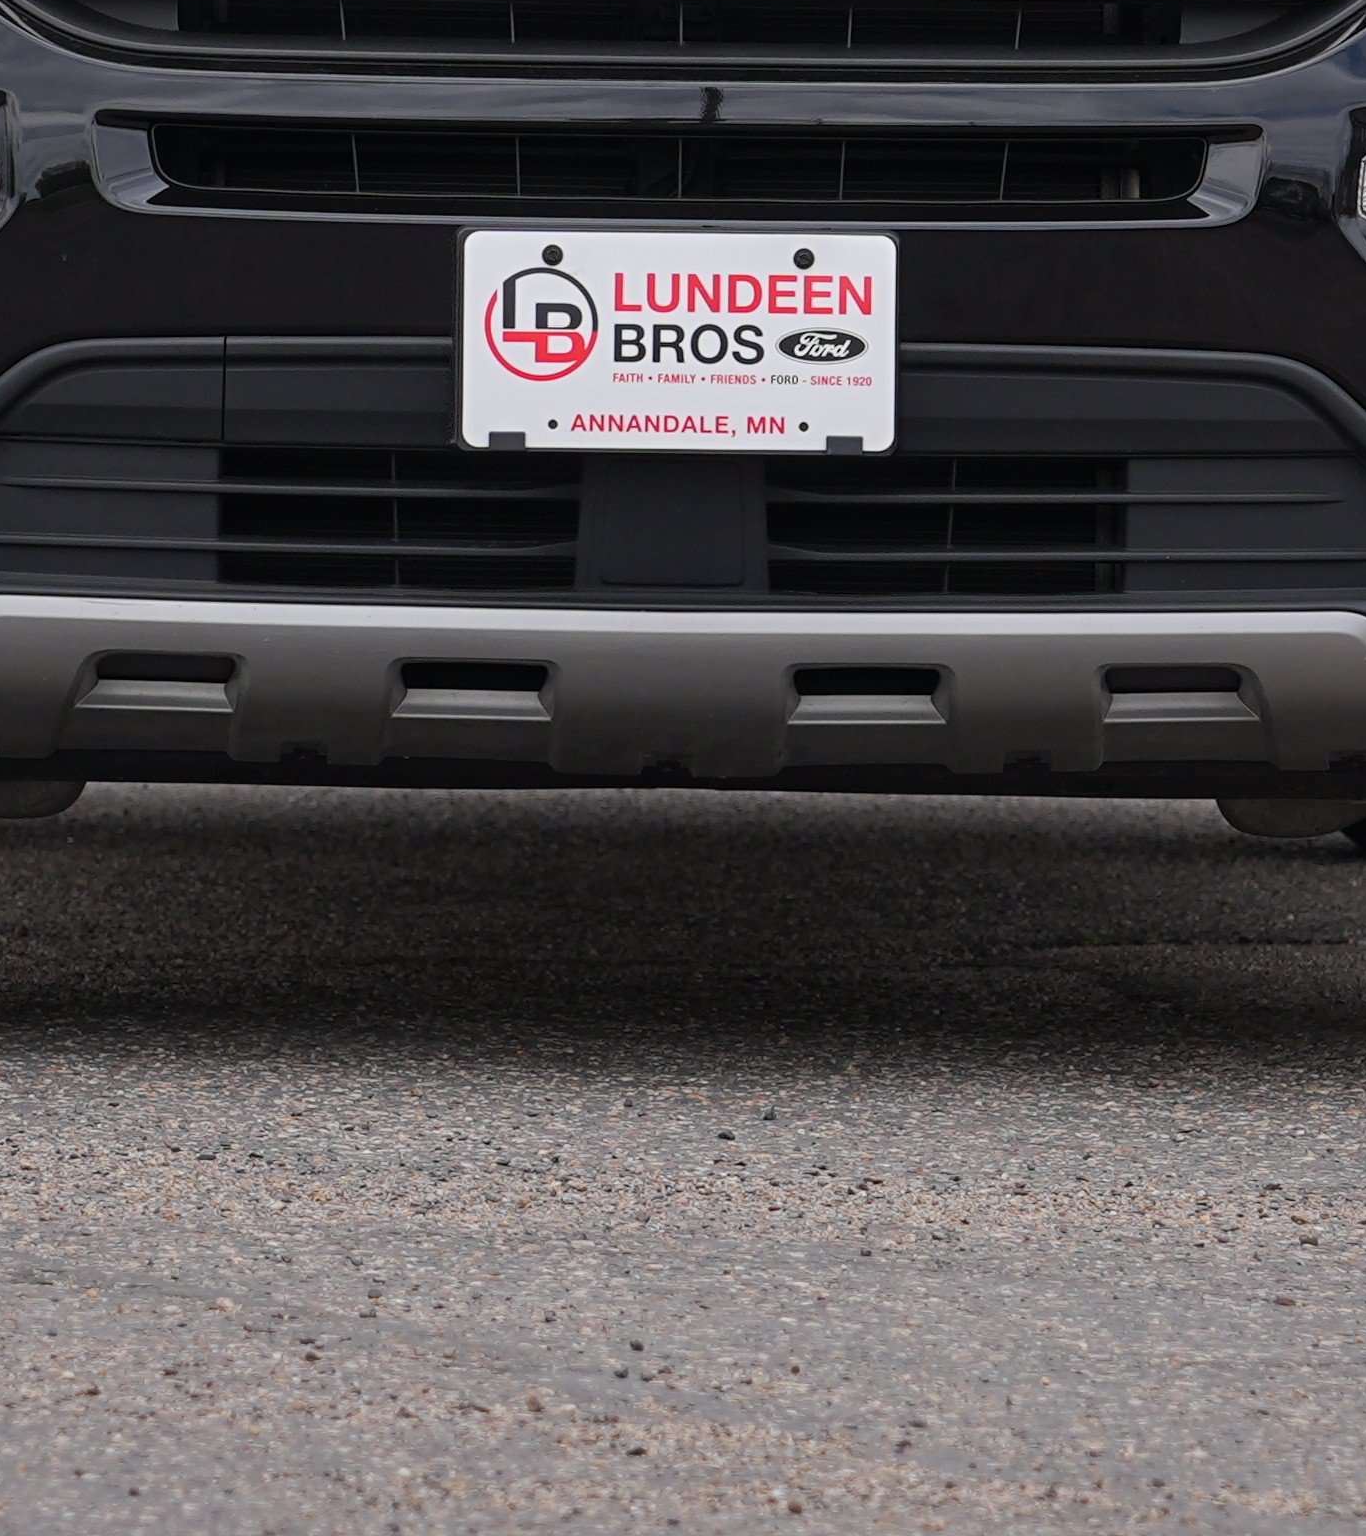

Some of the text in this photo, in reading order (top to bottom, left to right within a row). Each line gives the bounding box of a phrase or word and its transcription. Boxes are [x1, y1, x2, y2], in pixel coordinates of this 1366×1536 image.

[613, 272, 873, 316] LUNDEEN
[613, 323, 765, 366] BROS
[793, 331, 851, 359] Ford
[612, 372, 873, 387] FAITH FAMILY FRIENDS FORD SINCE 1920
[570, 413, 786, 438] ANNANDALE, MN
